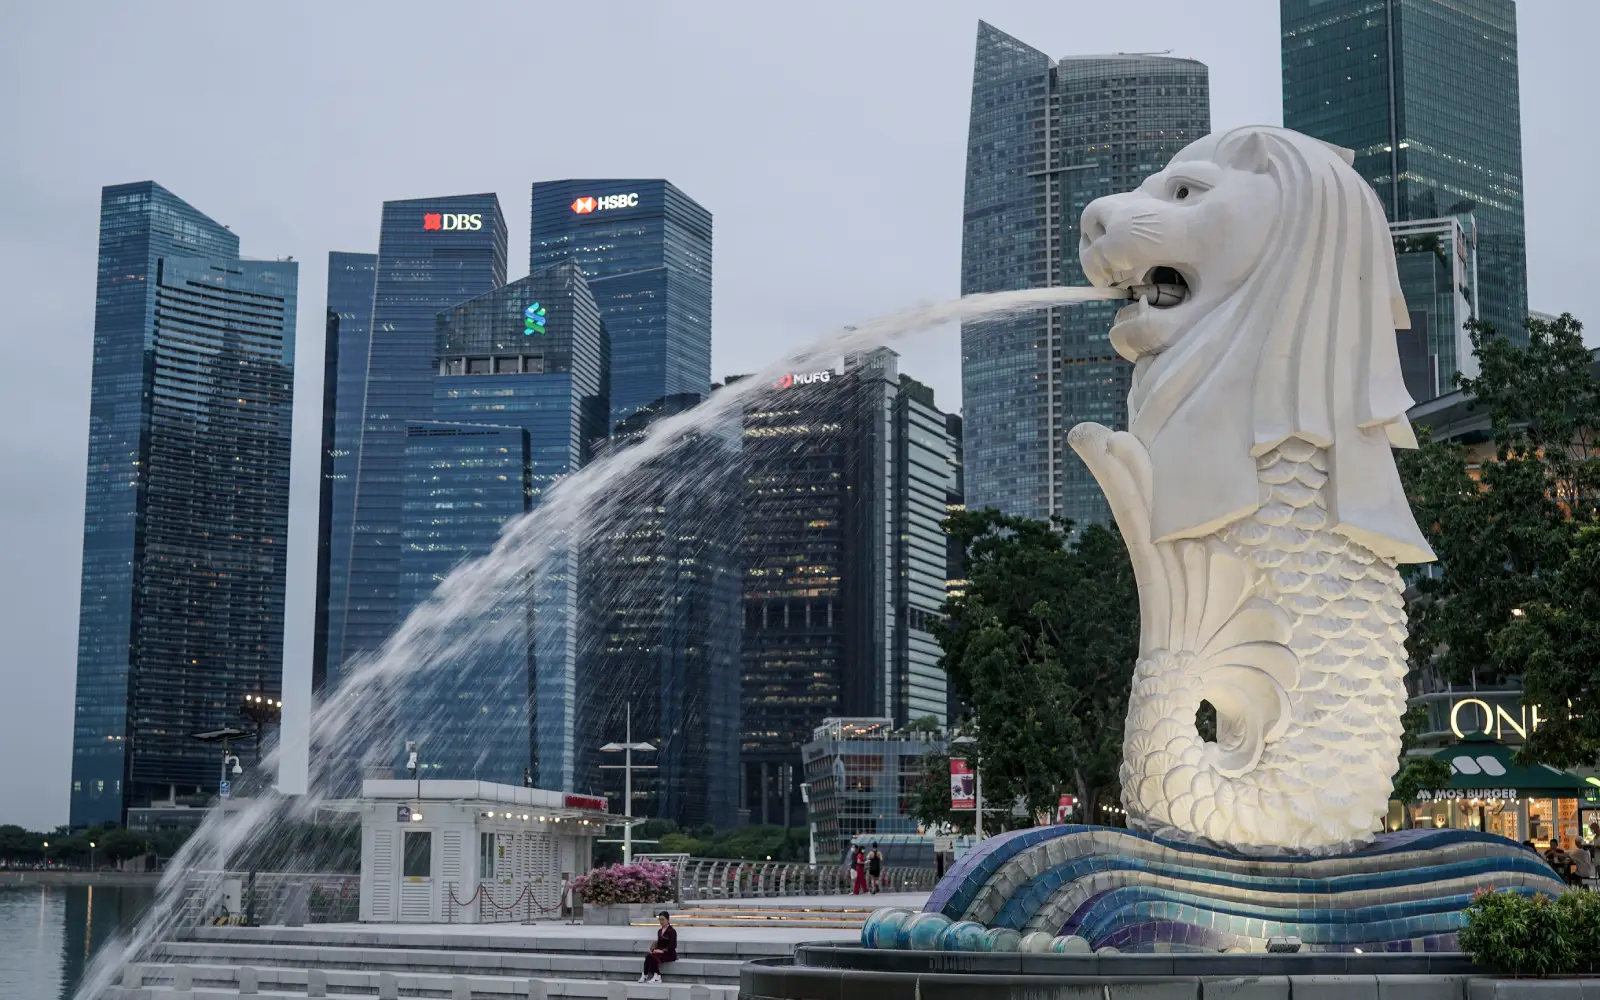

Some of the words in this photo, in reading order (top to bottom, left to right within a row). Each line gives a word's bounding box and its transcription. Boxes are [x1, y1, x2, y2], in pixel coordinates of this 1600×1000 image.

[597, 192, 639, 211] HSBC
[442, 213, 482, 231] DBS
[793, 371, 831, 385] MUFG
[1434, 788, 1465, 799] MOS
[1466, 788, 1517, 799] BURGER
